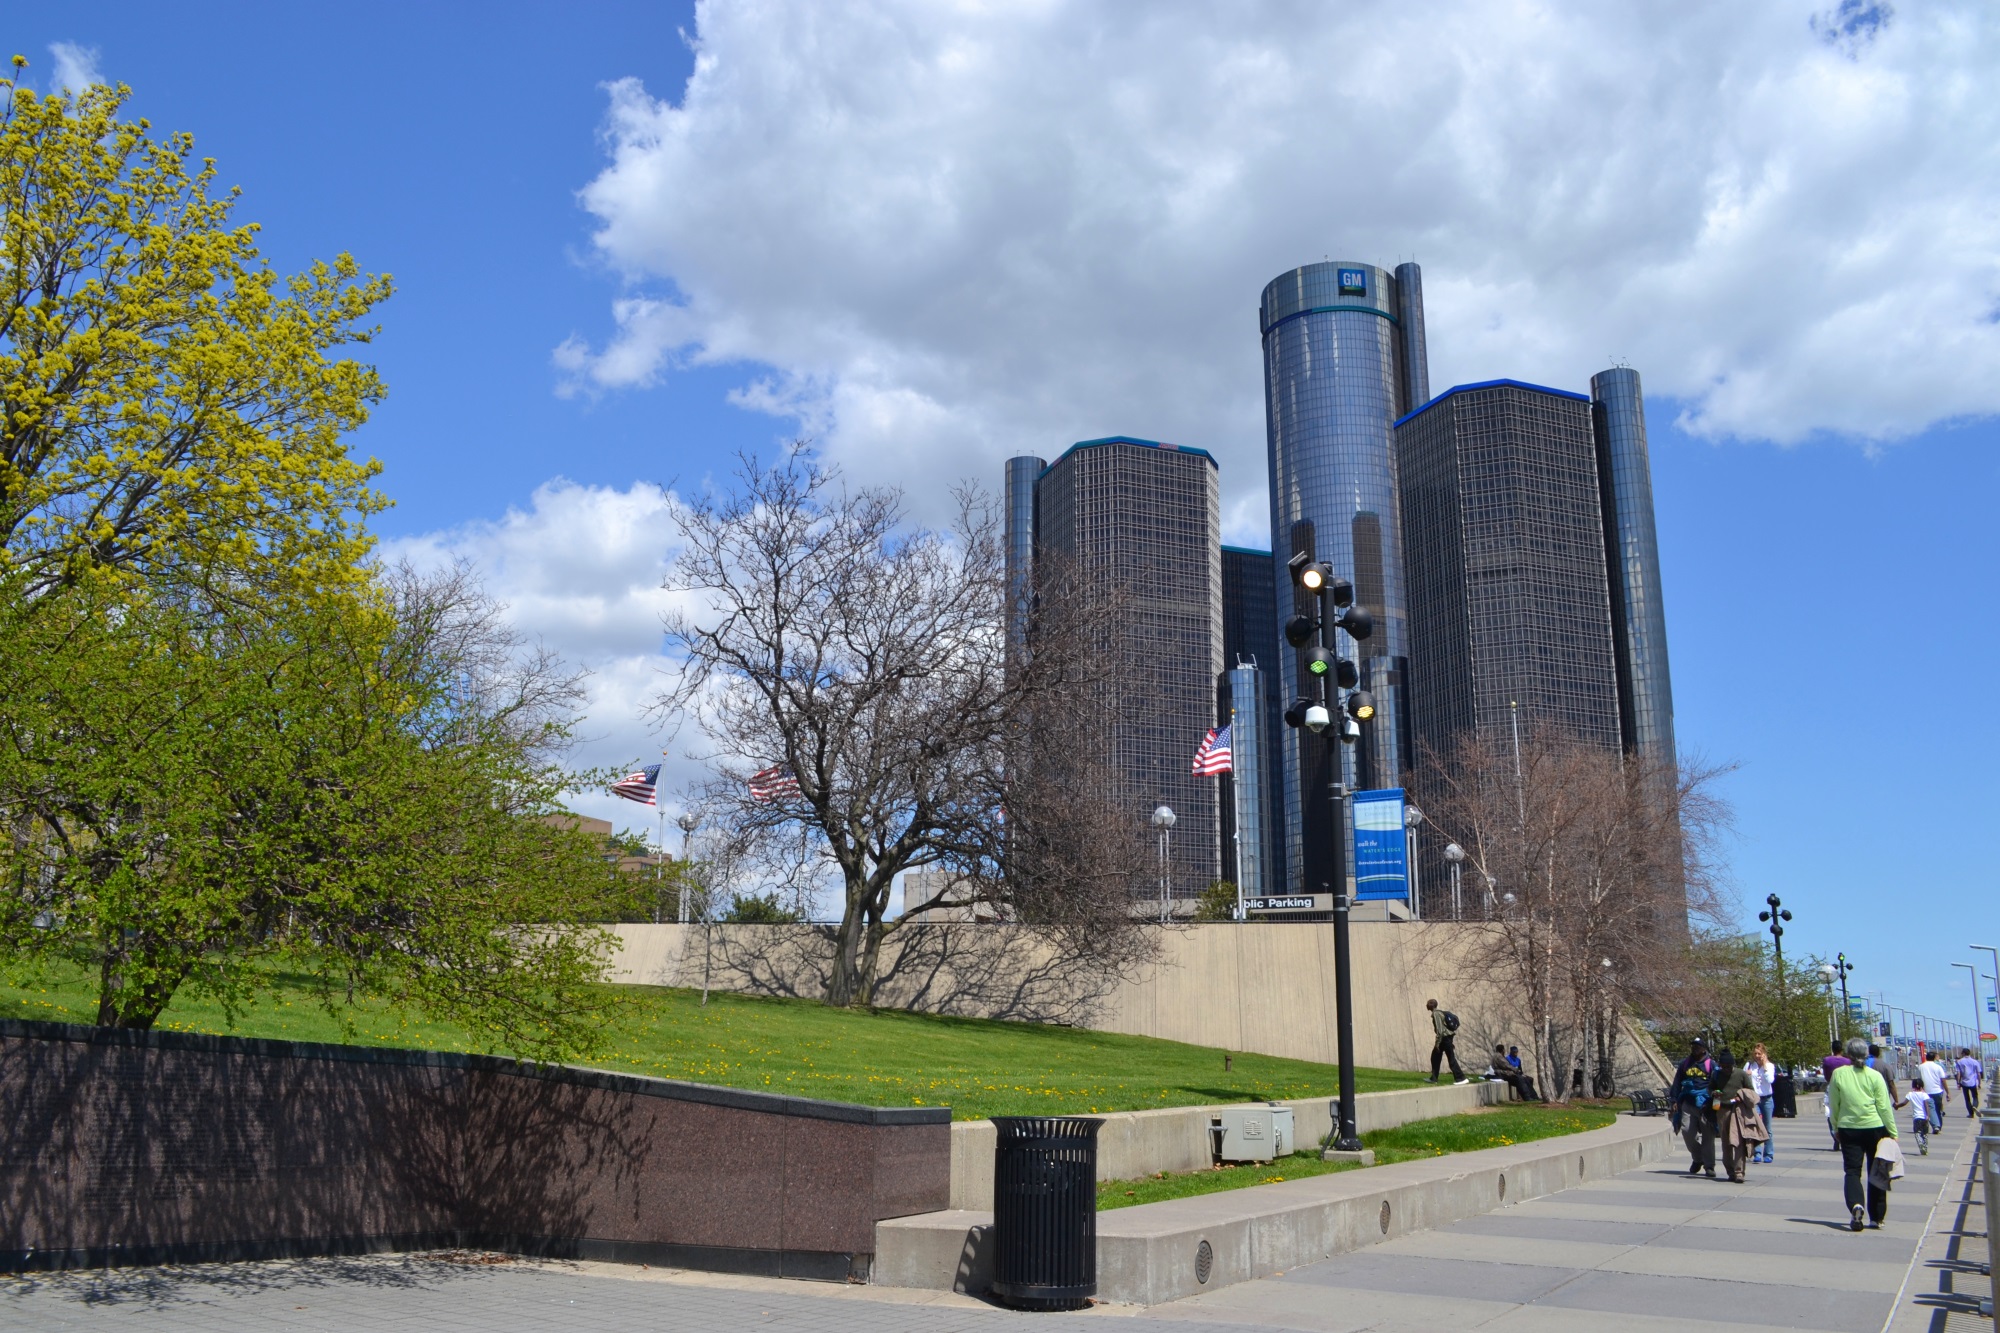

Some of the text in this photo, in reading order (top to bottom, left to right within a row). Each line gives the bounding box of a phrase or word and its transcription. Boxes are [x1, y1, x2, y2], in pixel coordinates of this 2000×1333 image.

[1343, 272, 1362, 286] GM
[1243, 897, 1312, 909] blic Parking
